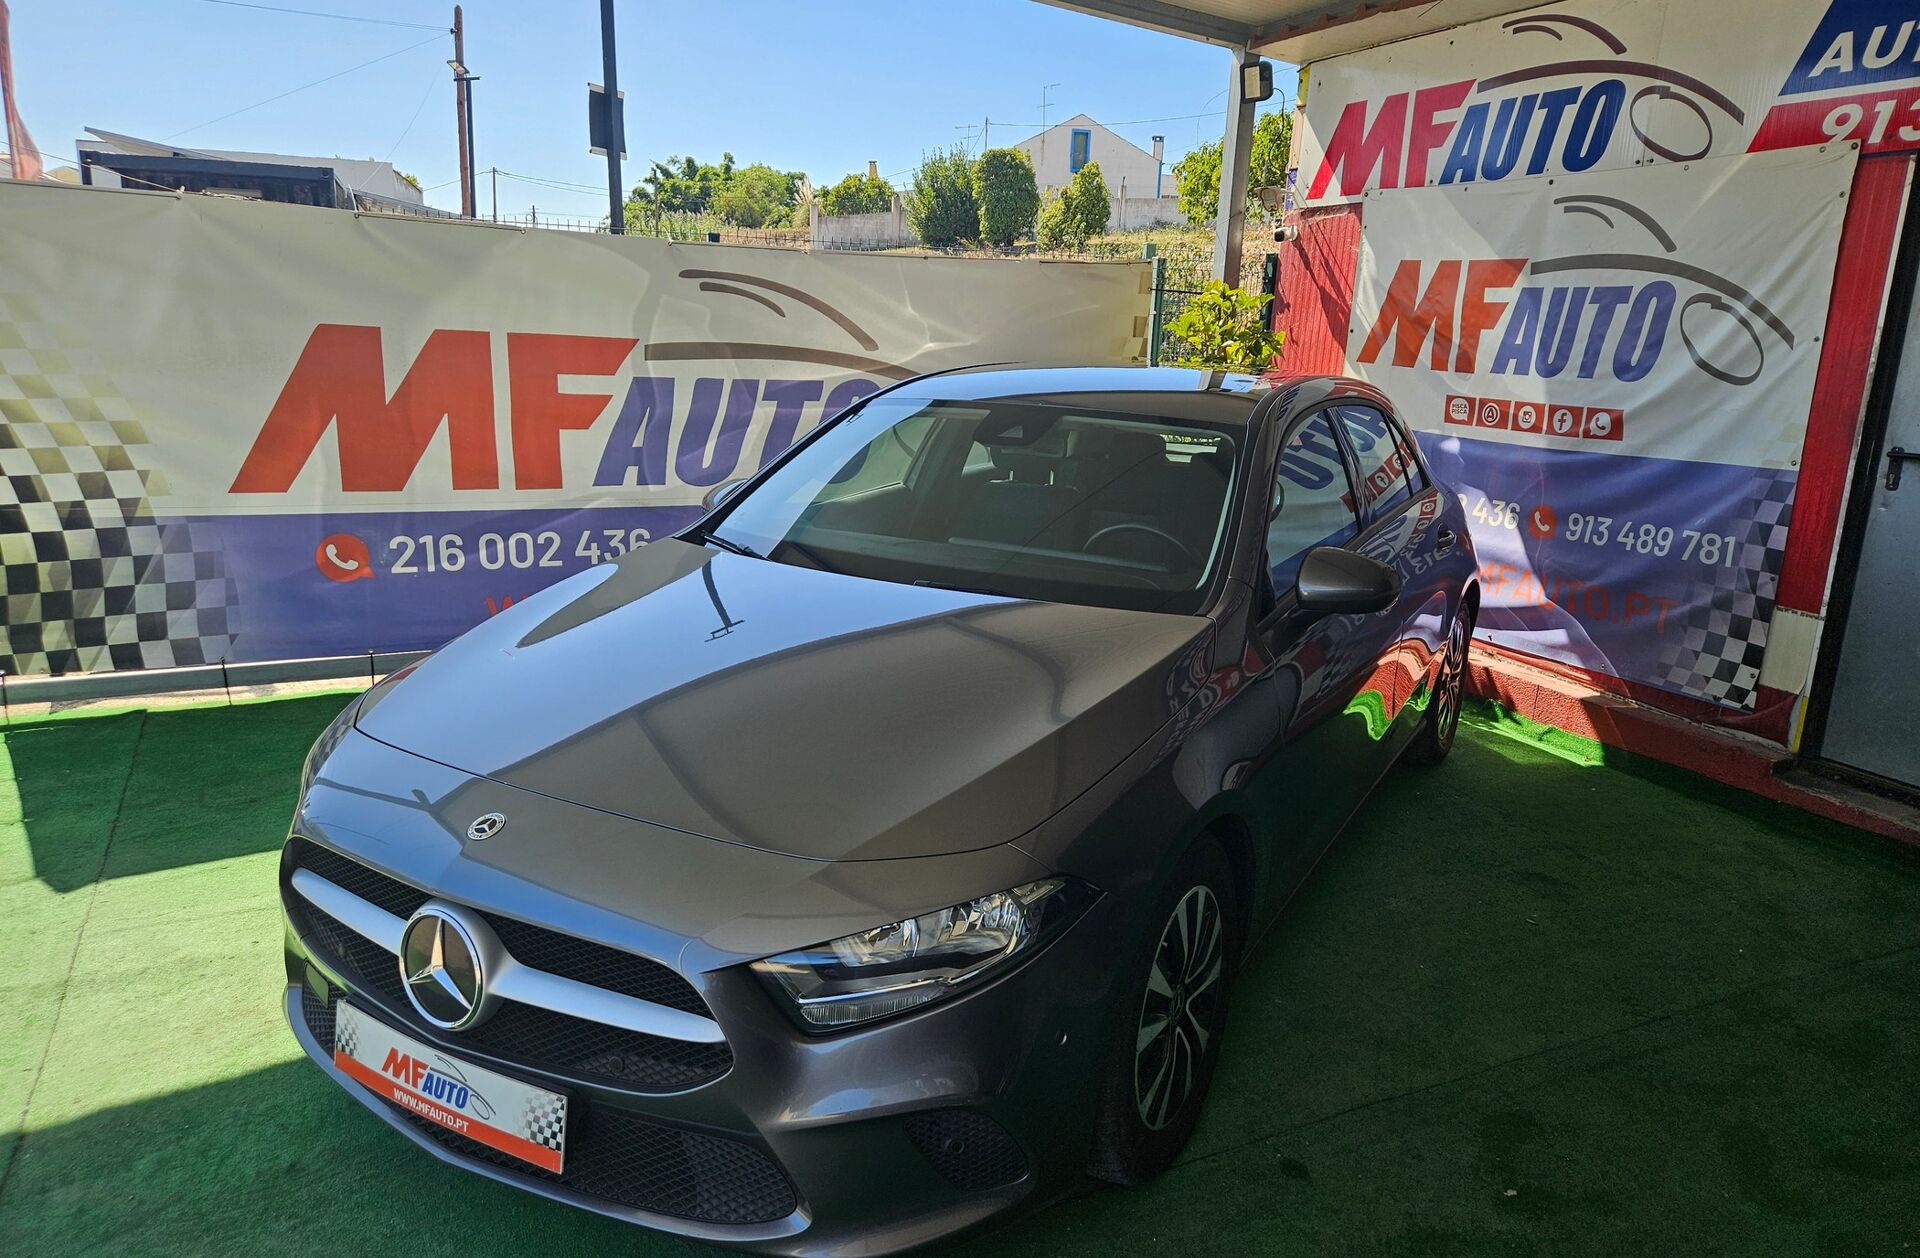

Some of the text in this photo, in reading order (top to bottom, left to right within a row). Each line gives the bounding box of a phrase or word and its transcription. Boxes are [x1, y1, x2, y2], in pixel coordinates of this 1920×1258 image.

[1808, 20, 1920, 78] AU
[389, 534, 465, 574] 216
[478, 531, 563, 570] 002
[1471, 497, 1520, 530] 436
[1565, 513, 1613, 546] 913
[1617, 521, 1674, 557] 489
[1681, 530, 1737, 567] 781
